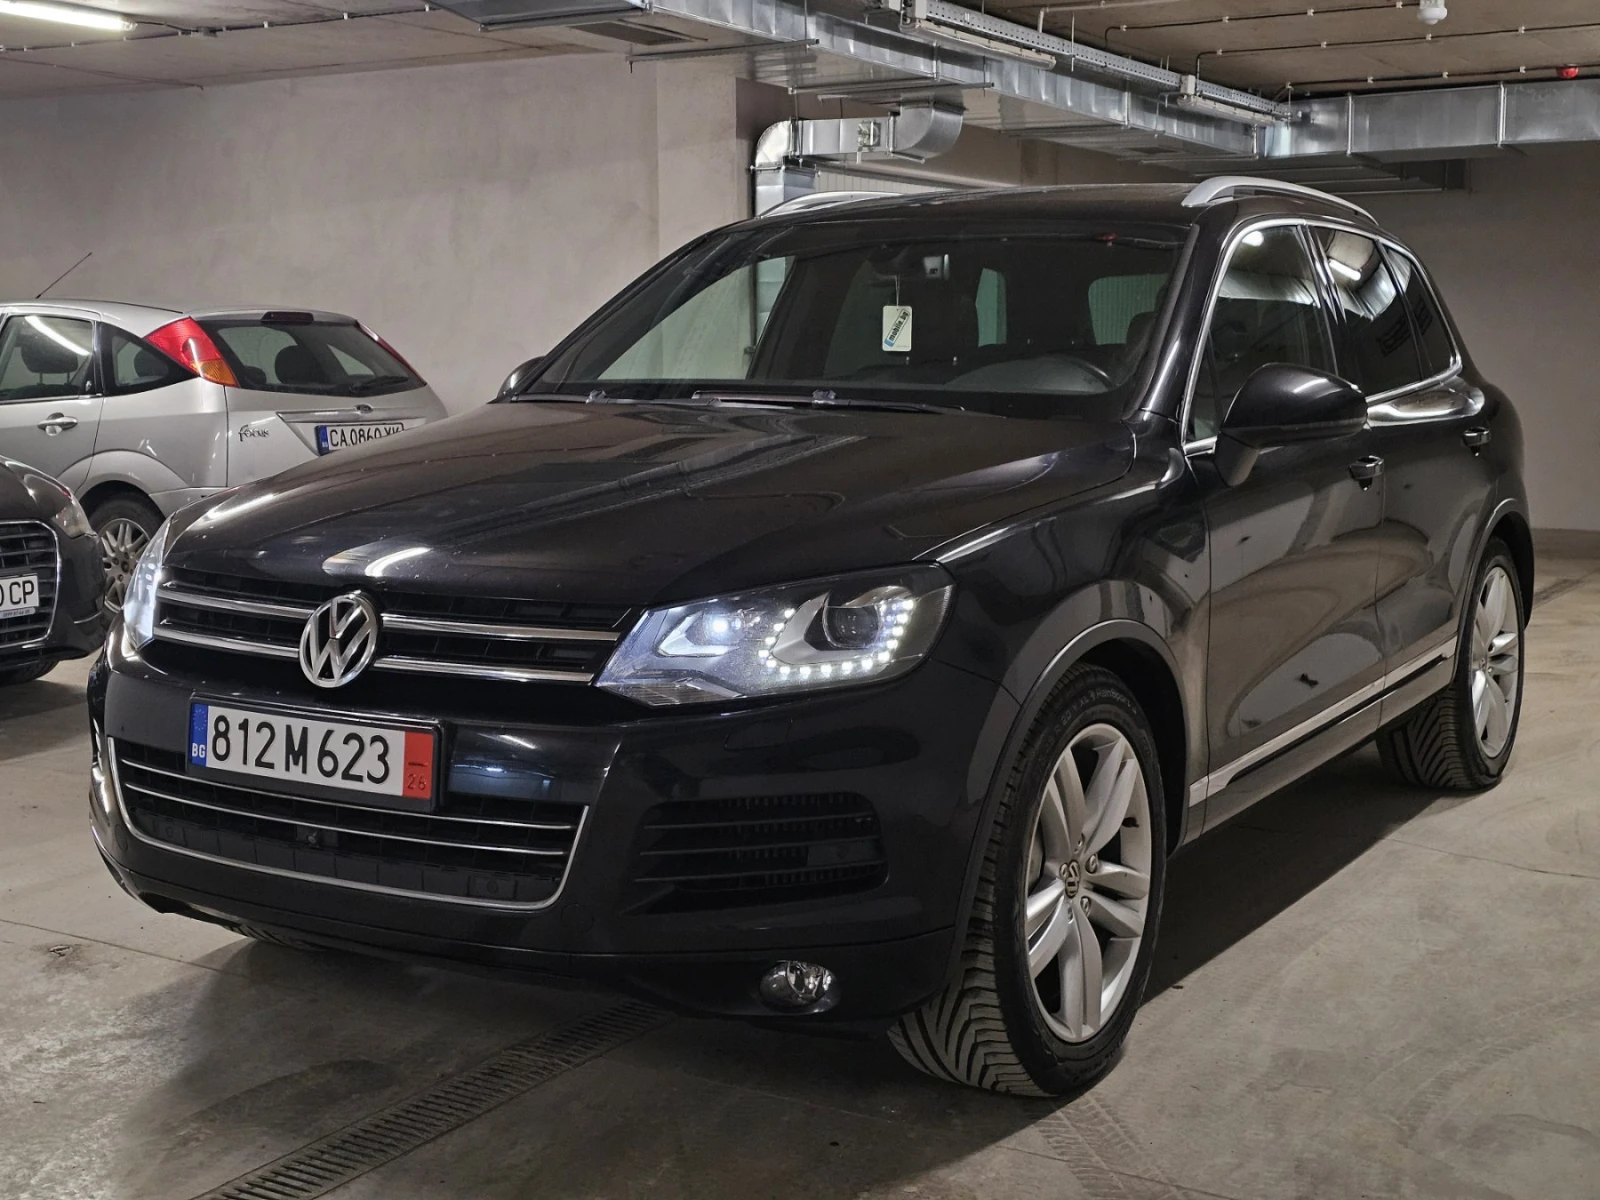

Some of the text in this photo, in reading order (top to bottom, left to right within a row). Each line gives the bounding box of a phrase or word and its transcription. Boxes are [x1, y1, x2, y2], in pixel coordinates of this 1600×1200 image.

[330, 429, 348, 447] CA
[191, 742, 206, 759] BG
[211, 714, 390, 785] 812M623
[407, 773, 427, 791] 26
